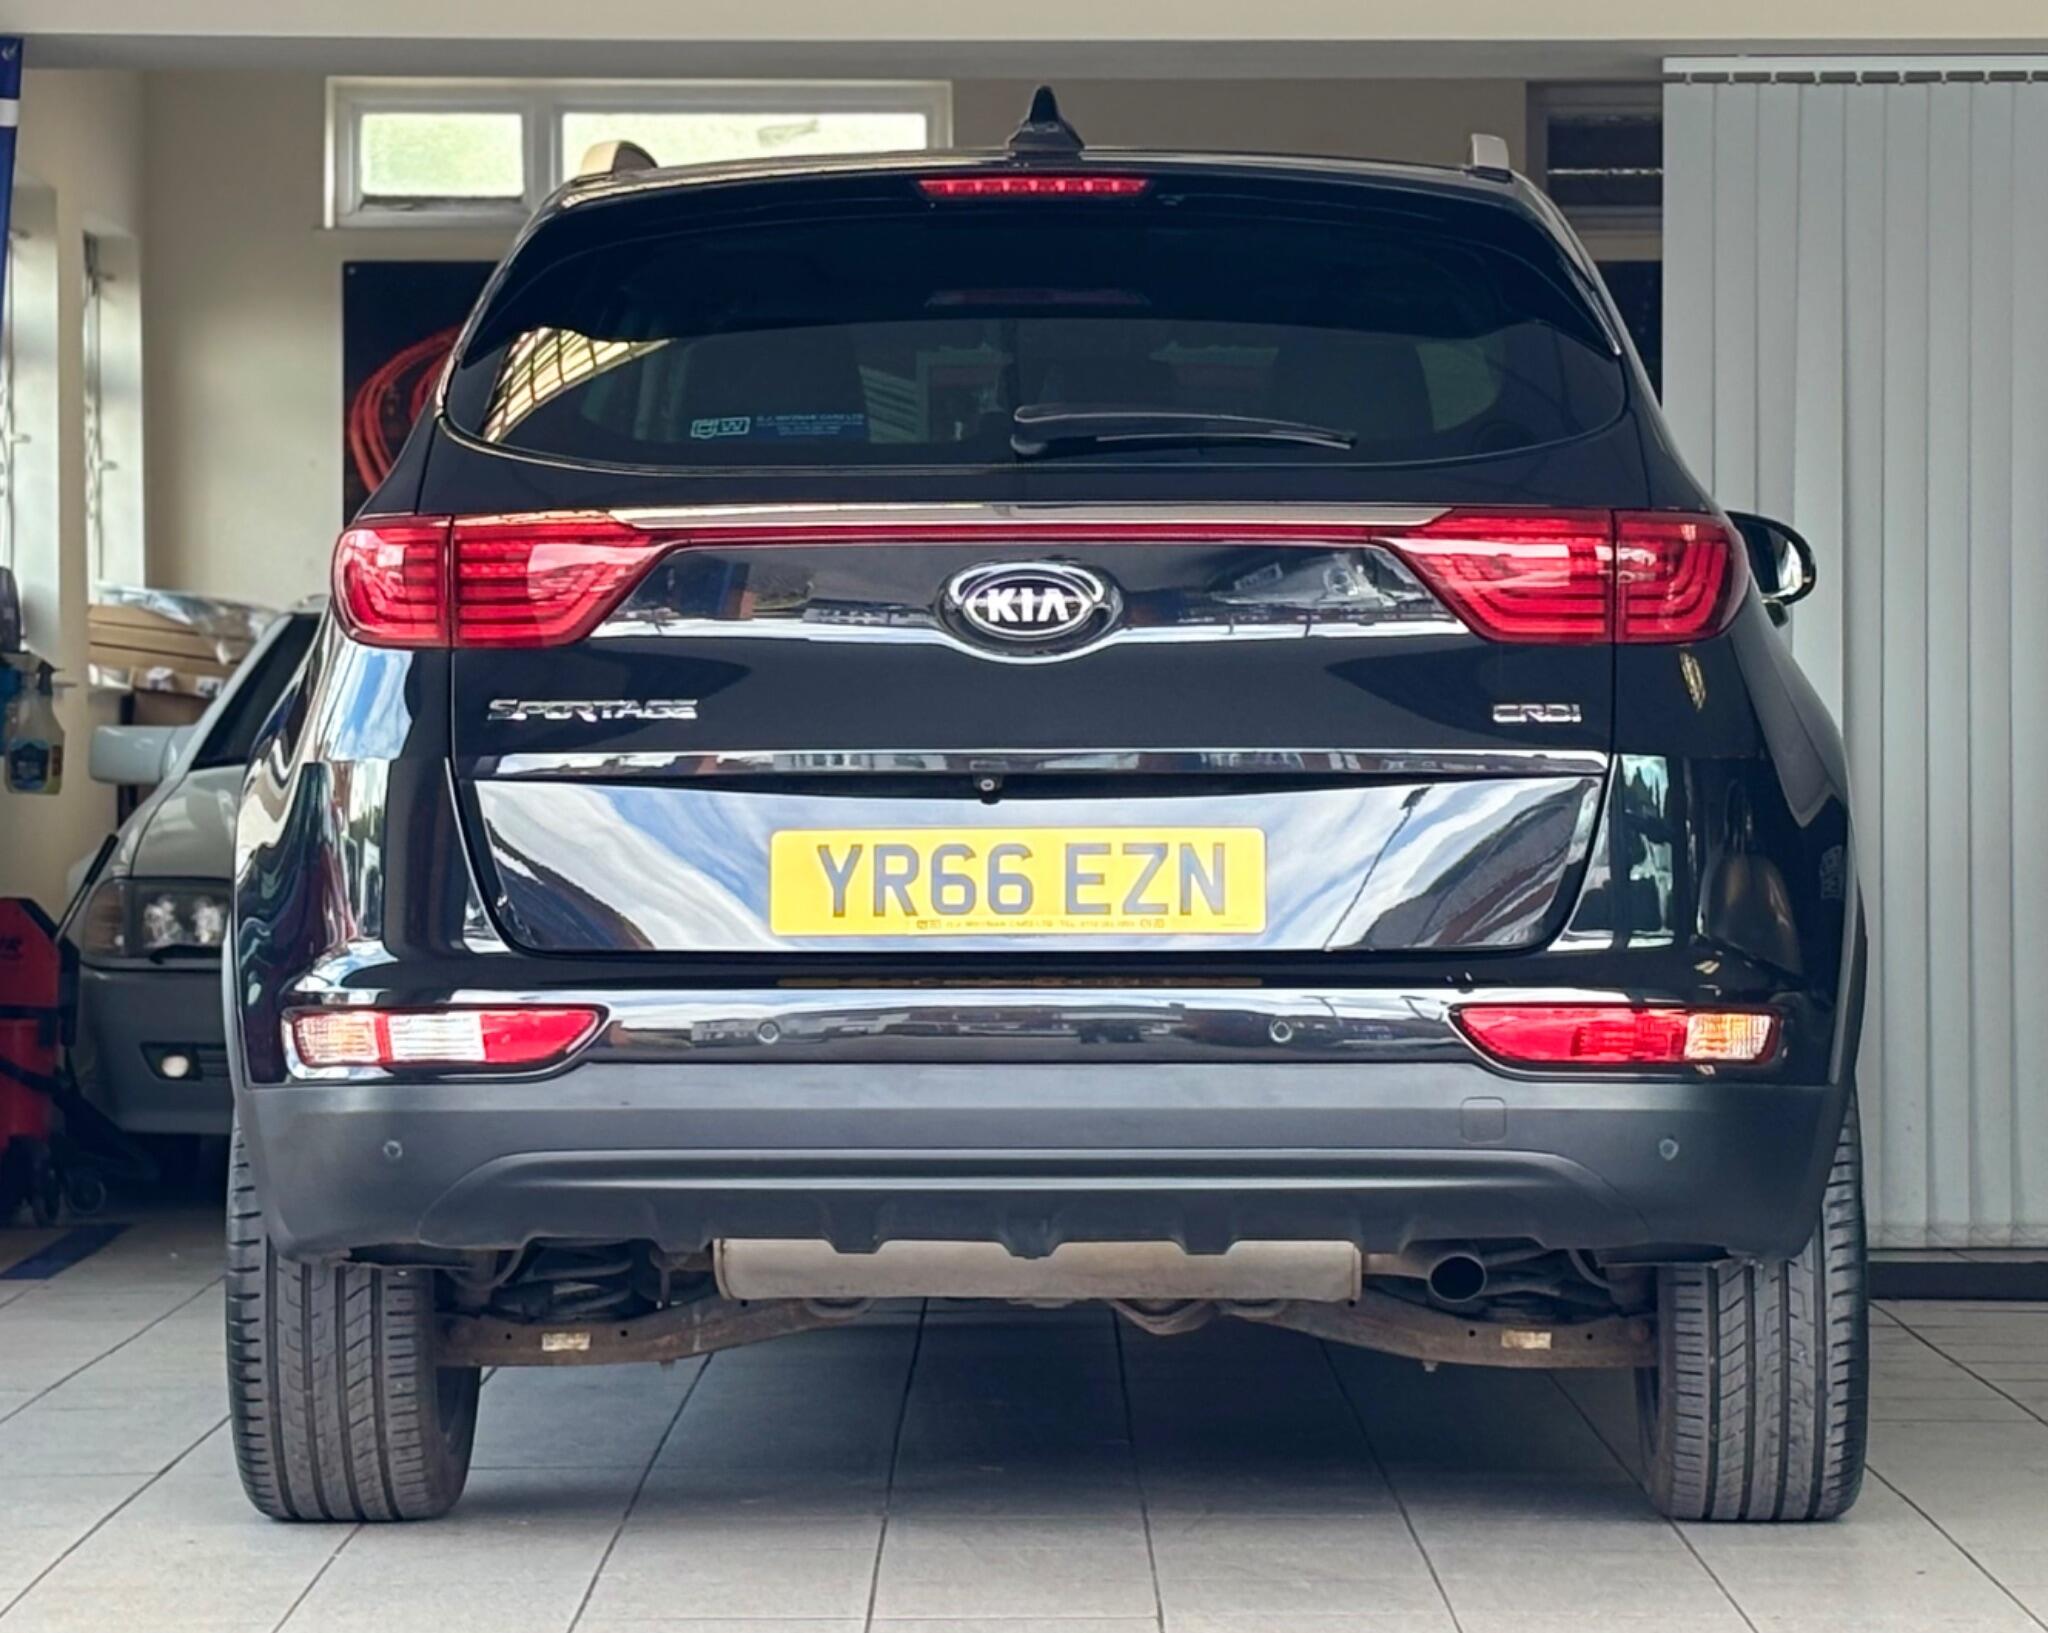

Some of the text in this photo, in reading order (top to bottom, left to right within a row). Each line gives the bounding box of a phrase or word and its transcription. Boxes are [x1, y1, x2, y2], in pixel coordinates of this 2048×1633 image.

[986, 587, 1070, 623] KIA
[487, 699, 698, 722] SPORTAGE
[816, 842, 1226, 918] YR66 EZN
